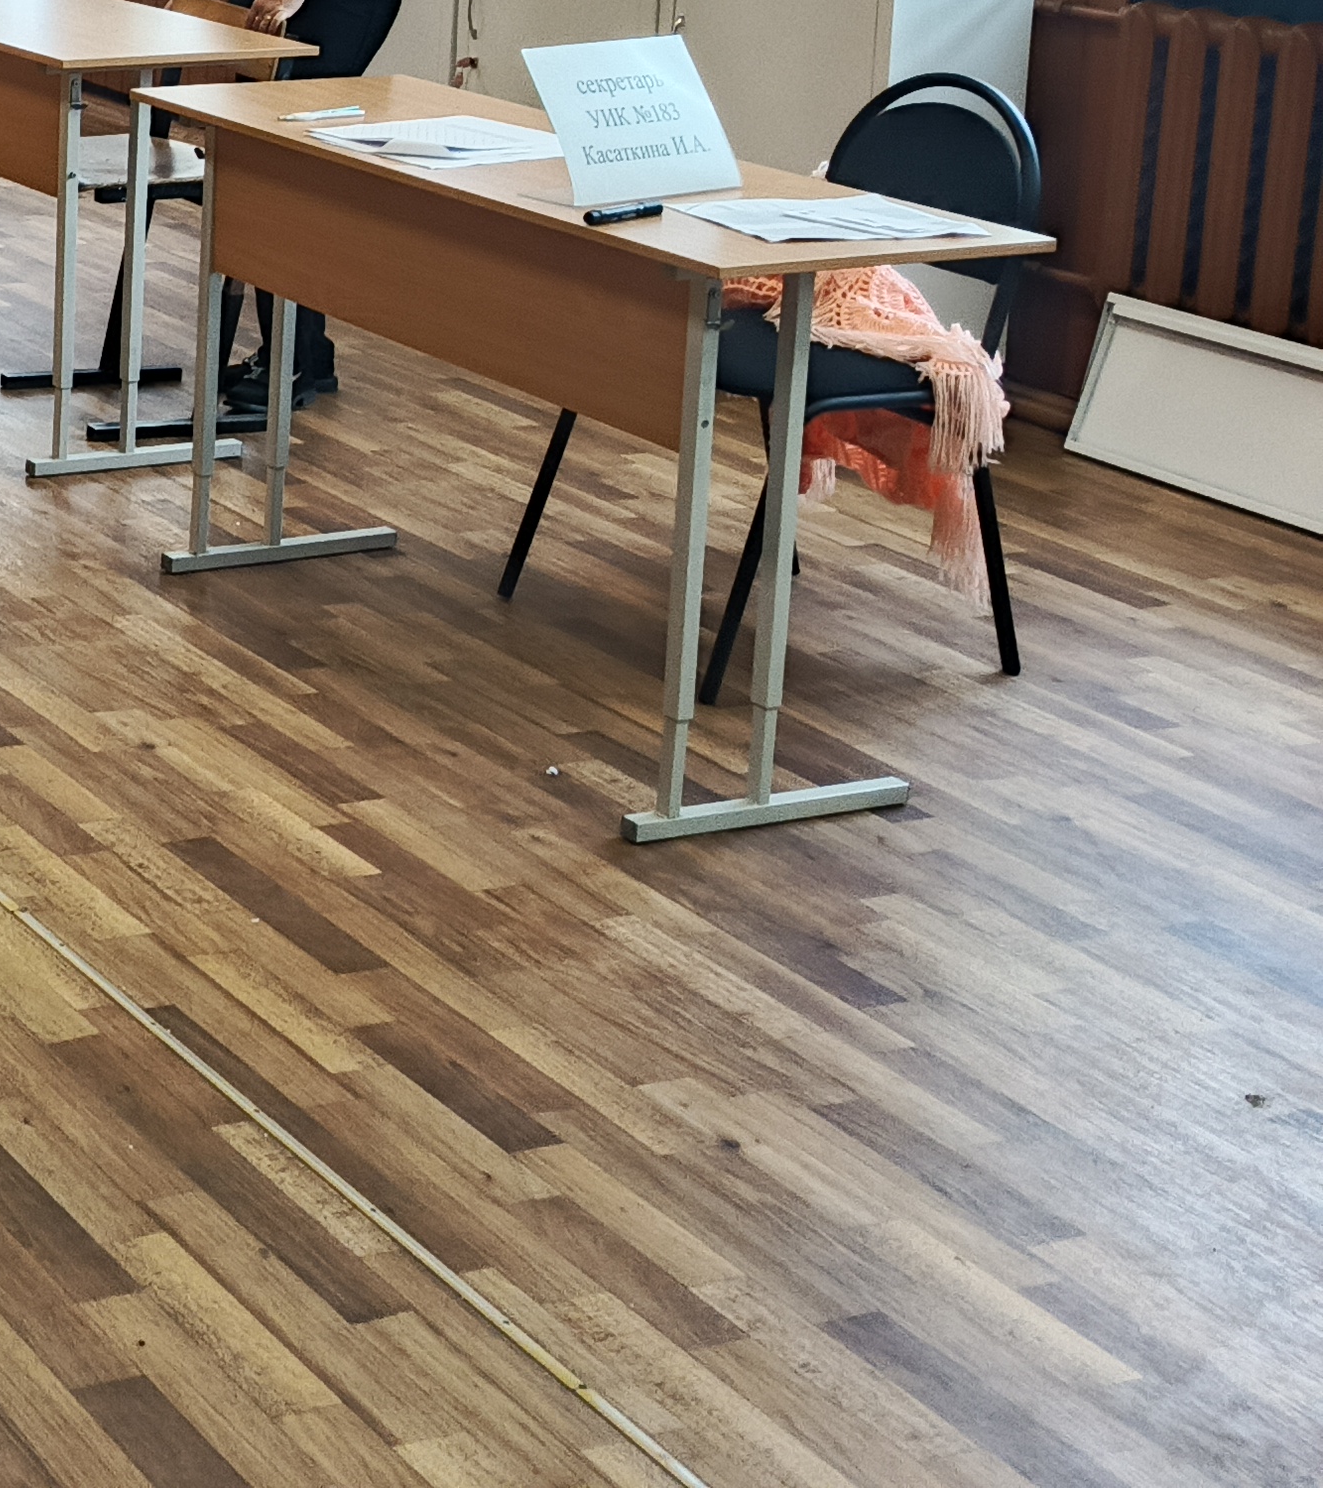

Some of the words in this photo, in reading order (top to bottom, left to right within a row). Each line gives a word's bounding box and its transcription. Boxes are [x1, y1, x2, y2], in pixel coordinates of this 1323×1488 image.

[576, 73, 665, 98] секретарь
[585, 106, 632, 129] УИК
[632, 102, 681, 125] №183
[581, 142, 671, 166] Касаткина
[670, 134, 712, 156] И.А.
